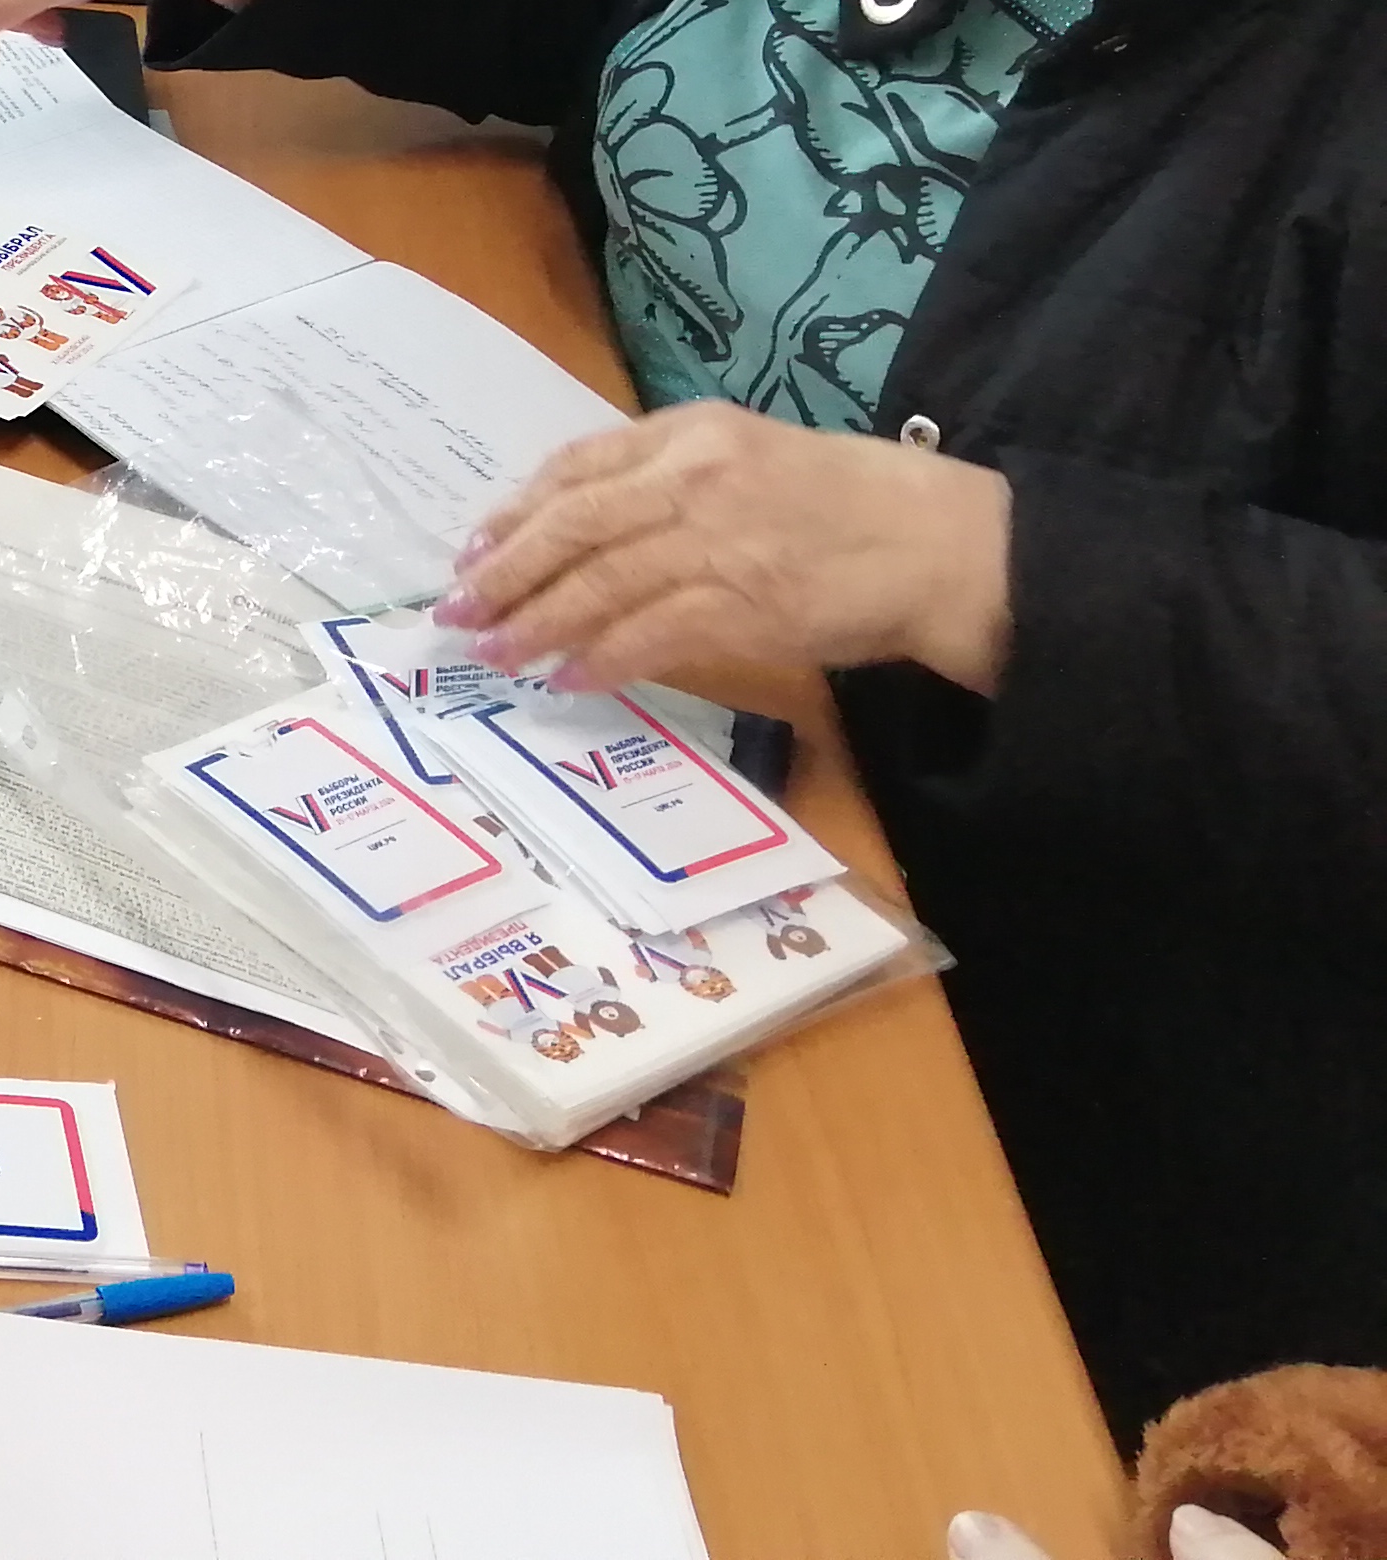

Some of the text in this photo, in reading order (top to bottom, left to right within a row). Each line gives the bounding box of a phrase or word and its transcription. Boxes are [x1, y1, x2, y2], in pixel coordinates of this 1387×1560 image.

[605, 734, 648, 755] ВЫБОРЫ
[610, 739, 672, 764] ПРЕЗИДЕНТА
[616, 756, 657, 776] РОССИИ
[317, 773, 360, 797] ВЫБОРЫ
[323, 776, 384, 807] ПРЕЗИДЕНТА
[329, 795, 369, 817] РОССИИ
[429, 921, 529, 966] ПРЕЗИДЕНТА
[442, 931, 543, 981] Я ВЫБРАЛ
